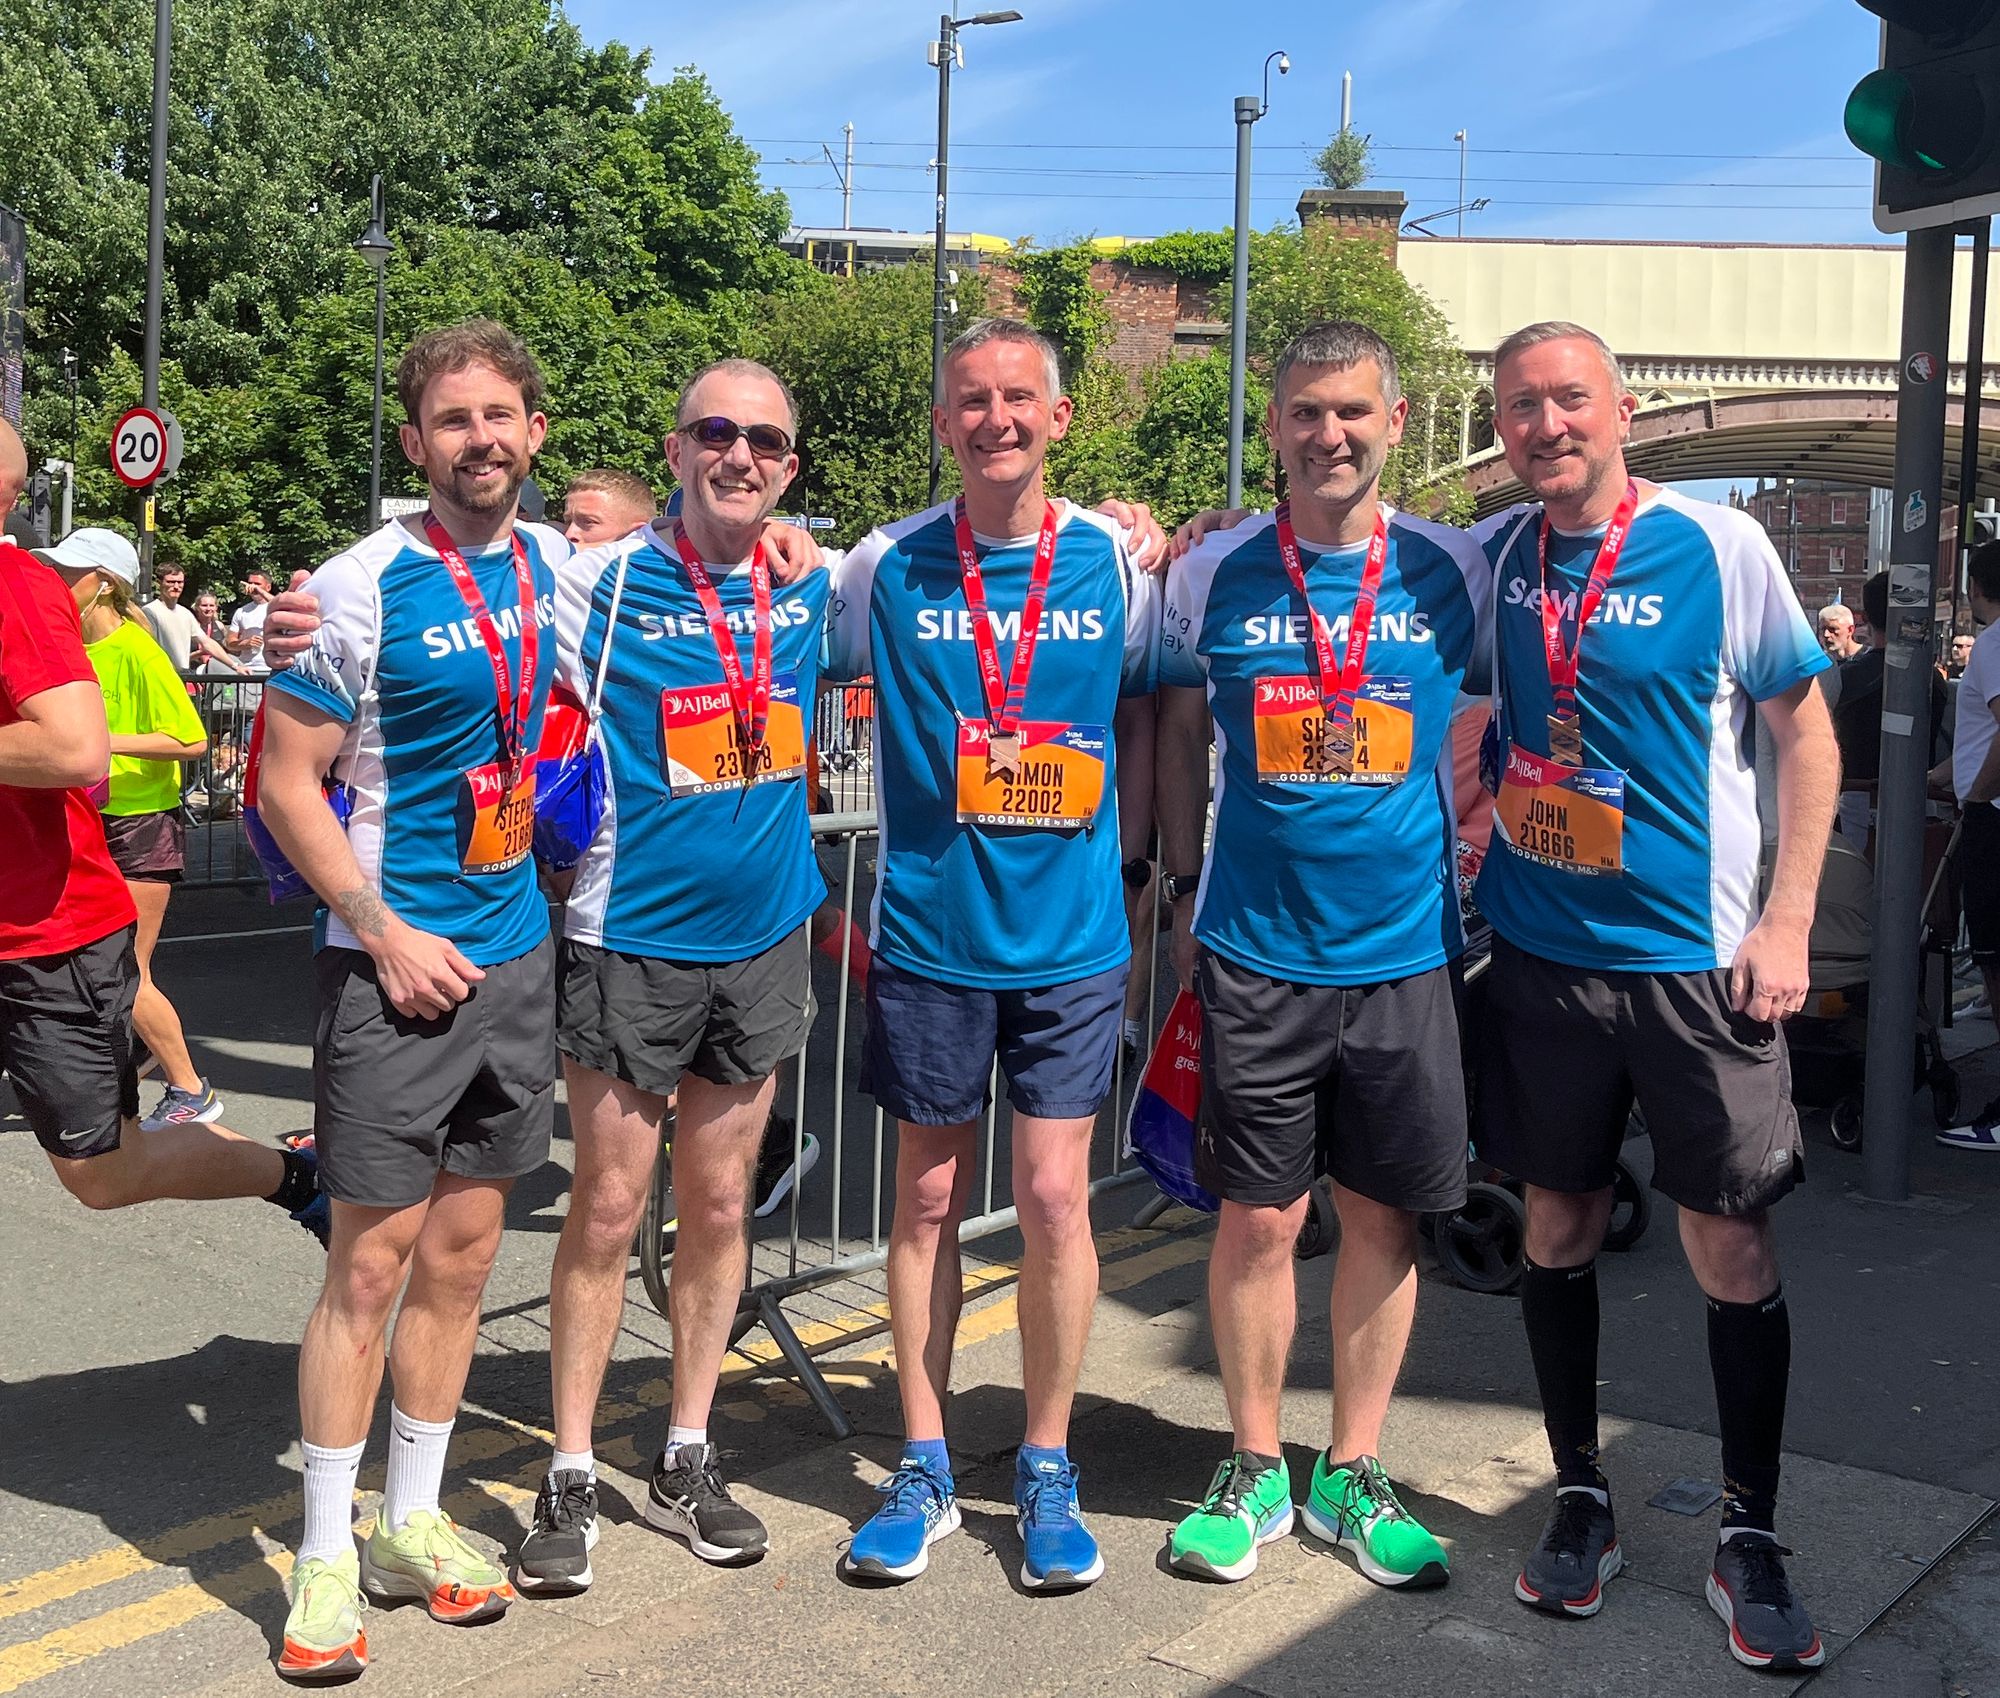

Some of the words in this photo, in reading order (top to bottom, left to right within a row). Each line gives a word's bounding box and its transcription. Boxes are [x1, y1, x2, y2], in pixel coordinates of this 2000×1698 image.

[120, 432, 159, 463] 20
[386, 499, 424, 509] CASTLE
[1040, 528, 1053, 560] 2023
[1370, 534, 1384, 565] 2023
[1606, 525, 1624, 554] 2023
[443, 551, 468, 578] 2023
[961, 550, 978, 578] 2023
[1282, 544, 1298, 569] 2023
[687, 561, 707, 586] 2023
[754, 566, 767, 593] 2023
[1504, 576, 1664, 627] SEMNS
[916, 609, 1104, 641] SIEMENS
[1016, 635, 1034, 665] AJBell
[1317, 643, 1333, 674] AJBell
[1350, 630, 1365, 661] AJBell
[495, 662, 508, 693] AJBell
[523, 656, 534, 688] AJBell
[726, 661, 741, 689] AJBell
[757, 658, 768, 687] AJBell
[982, 648, 999, 680] AJBell
[681, 692, 732, 716] AJBell
[1274, 685, 1325, 705] AJBell
[978, 728, 1028, 746] All
[1302, 717, 1368, 742] SHN
[714, 745, 773, 779] 238
[1302, 744, 1369, 770] 234
[1515, 759, 1543, 783] AJBell
[693, 774, 765, 794] GOODMOE
[776, 769, 793, 781] M&S
[1279, 773, 1358, 783] GOODMOVE
[1373, 773, 1392, 783] M&S
[1002, 788, 1063, 815] 22002
[1526, 798, 1568, 832] JOHN
[977, 814, 1051, 826] GOODMOVE
[1063, 818, 1081, 827] M&S
[1519, 822, 1576, 860] 21866
[1506, 843, 1563, 870] GOODMOVE
[1577, 864, 1600, 876] M&S
[1600, 856, 1614, 867] HM
[1182, 1030, 1201, 1051] AJ
